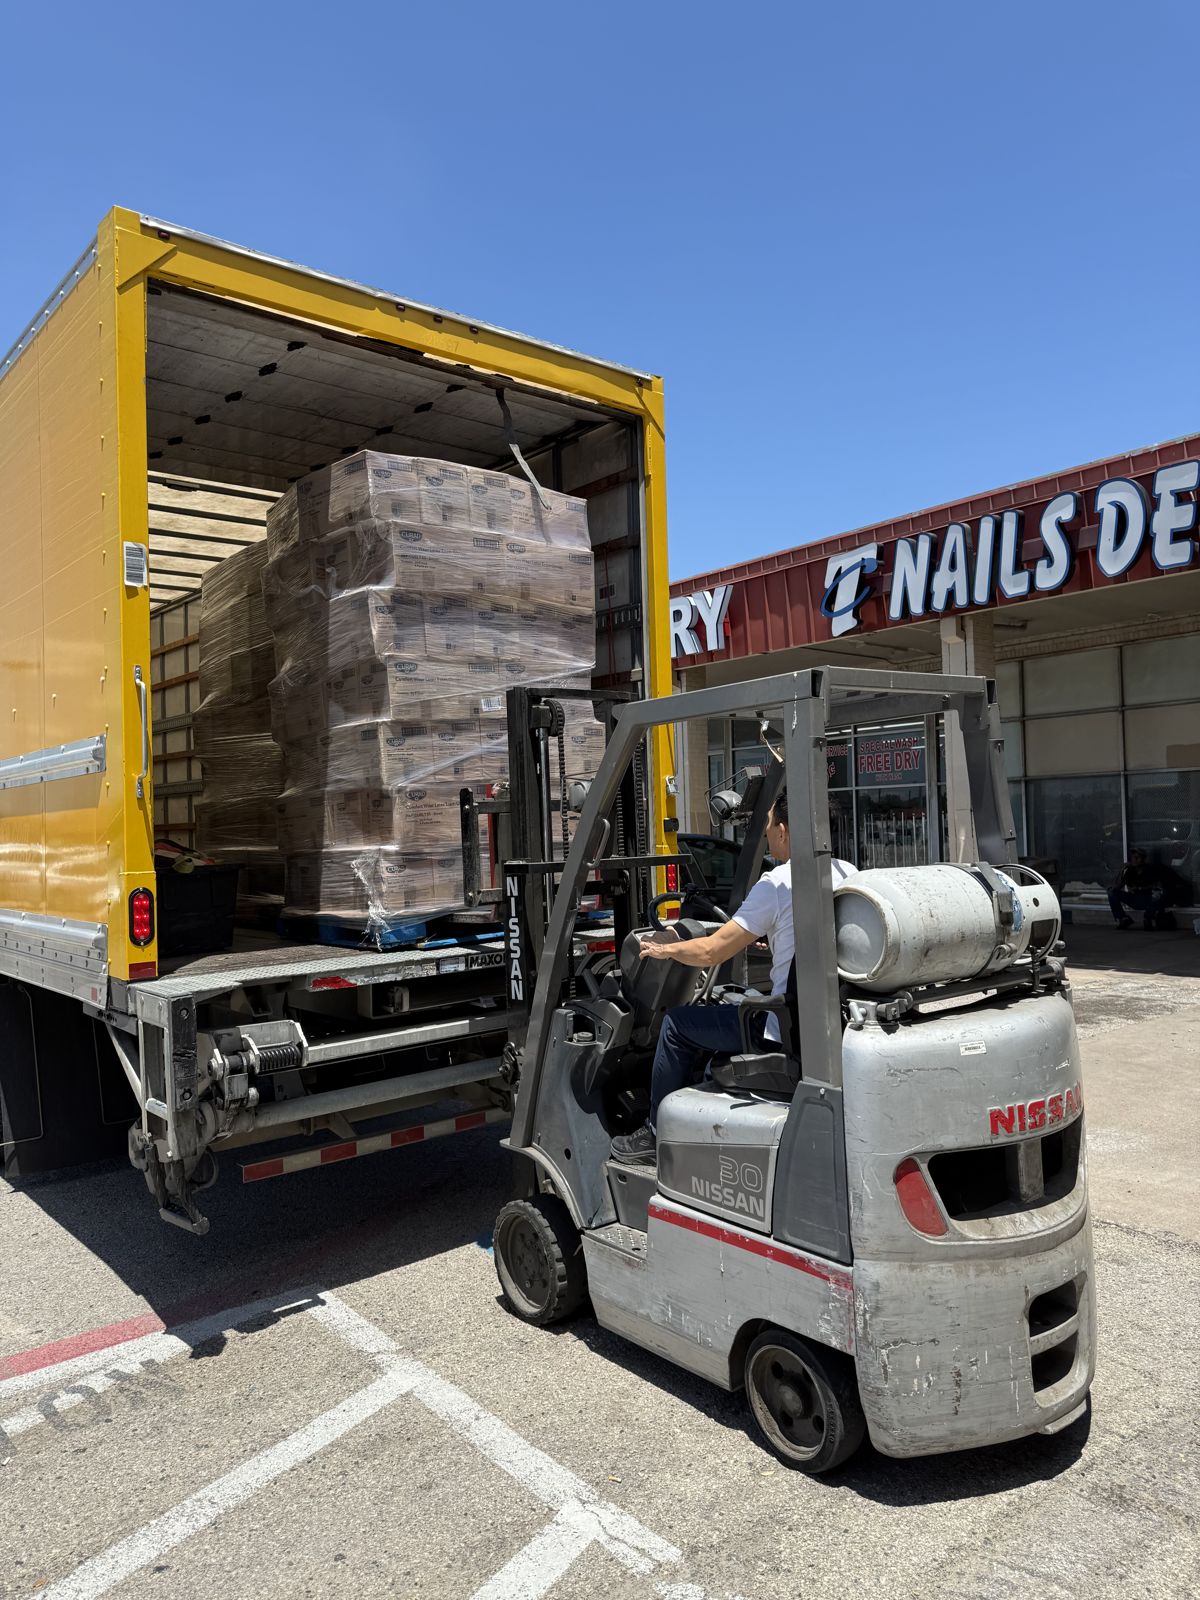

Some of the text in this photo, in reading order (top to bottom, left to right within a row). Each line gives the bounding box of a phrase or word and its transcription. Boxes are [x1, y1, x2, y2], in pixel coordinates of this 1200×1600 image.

[888, 490, 1079, 621] NAILS
[1094, 459, 1200, 578] DE
[858, 750, 921, 774] FREE DRY
[860, 737, 919, 753] SPECIAL WASH
[506, 876, 524, 1001] NISSAN
[470, 952, 506, 968] MAXO
[719, 1155, 763, 1193] 30
[691, 1175, 765, 1218] NISSAN
